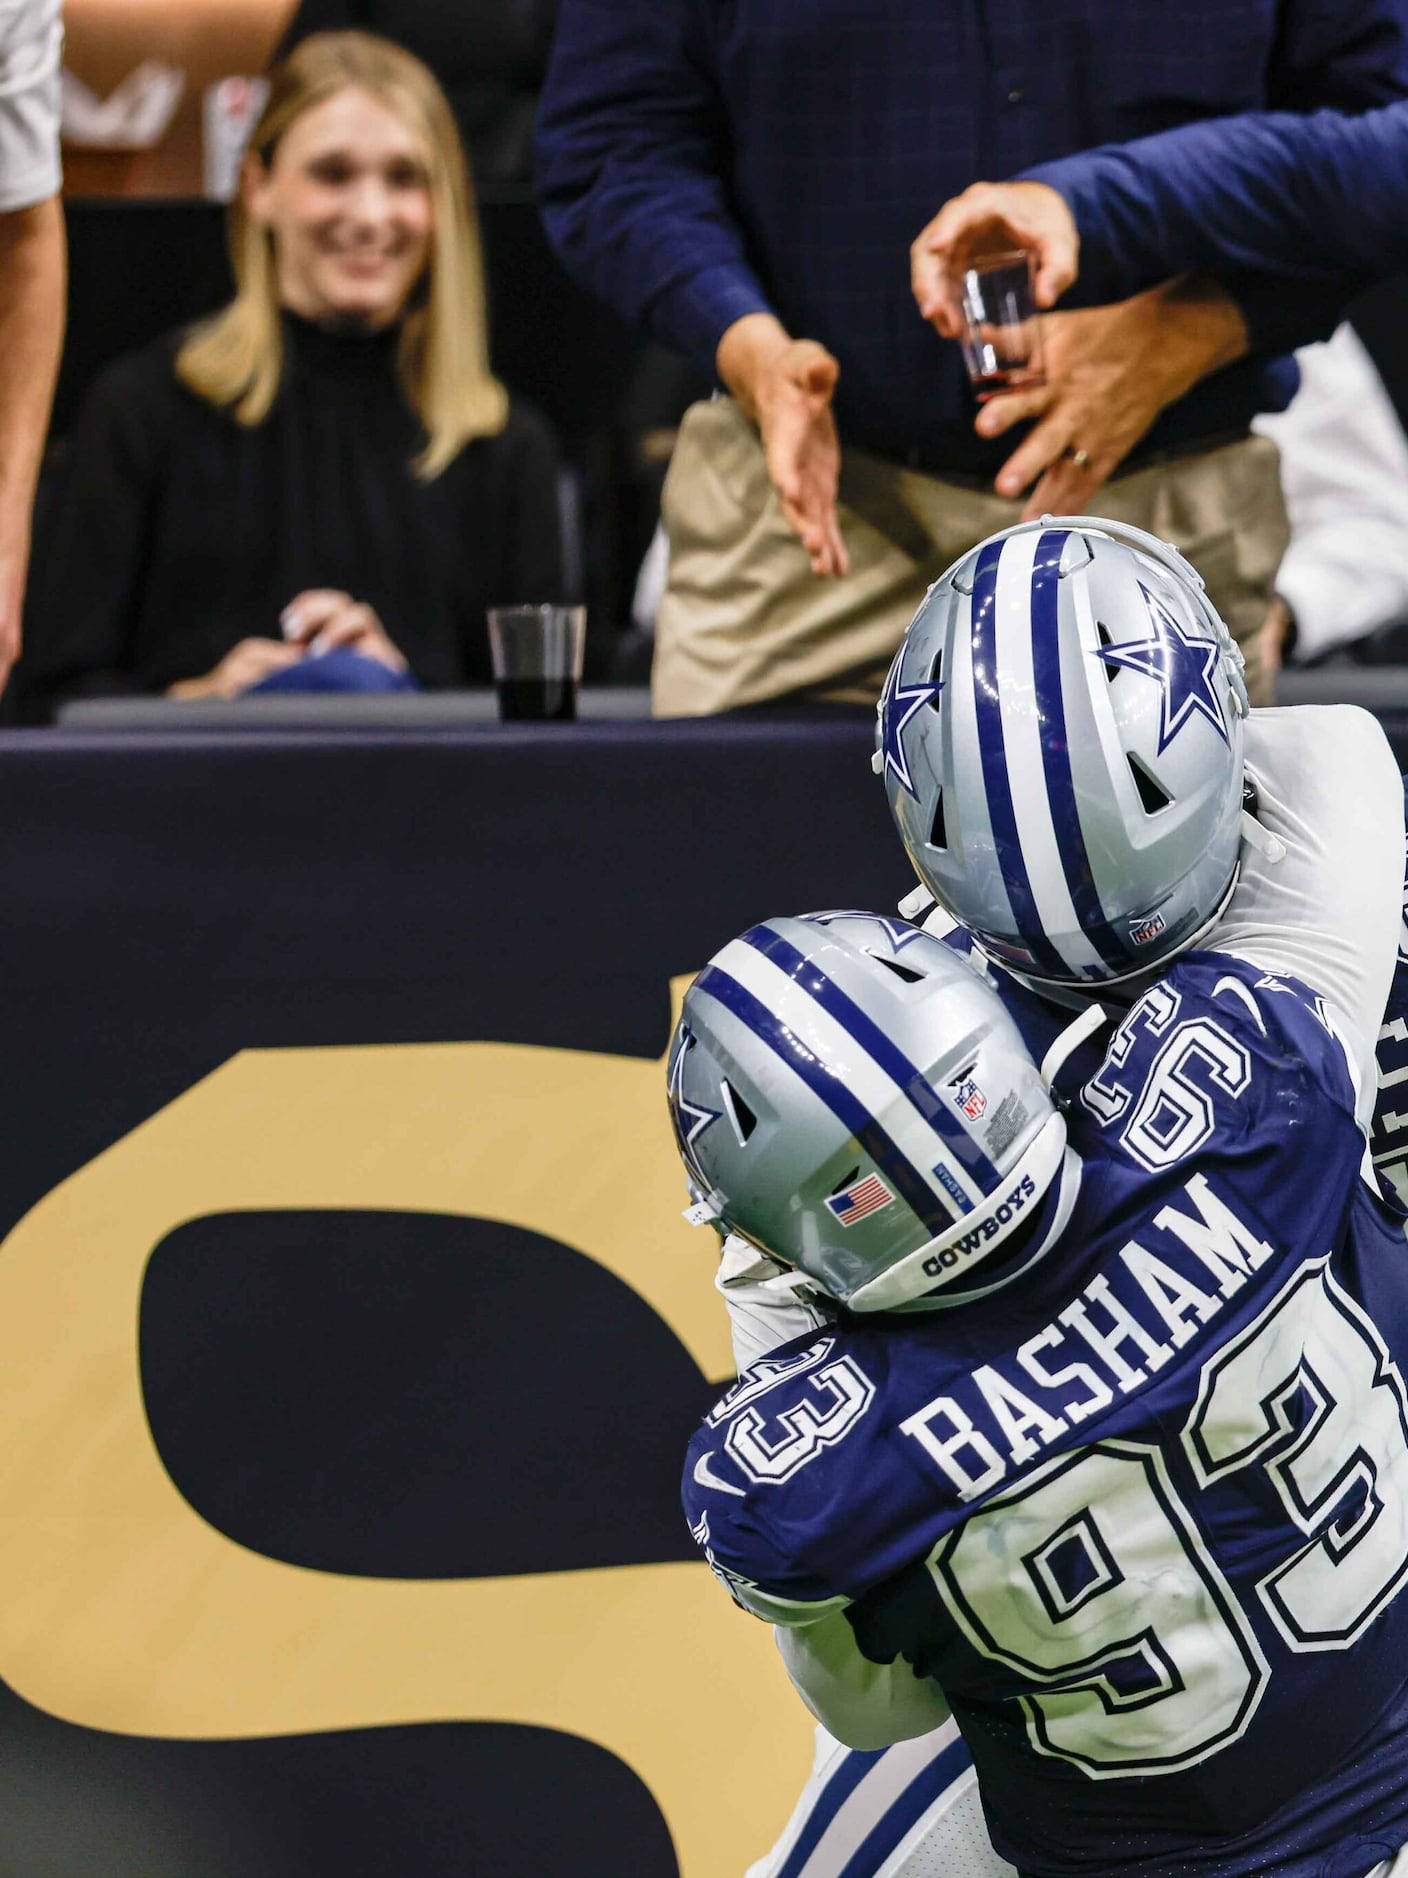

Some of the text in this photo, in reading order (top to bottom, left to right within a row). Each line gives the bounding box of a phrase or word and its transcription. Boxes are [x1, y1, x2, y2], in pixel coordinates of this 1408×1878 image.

[1137, 923, 1165, 943] NFL
[964, 1092, 985, 1118] NFL
[921, 1174, 1036, 1277] COWBOYS
[899, 1172, 1274, 1503] BASHAM
